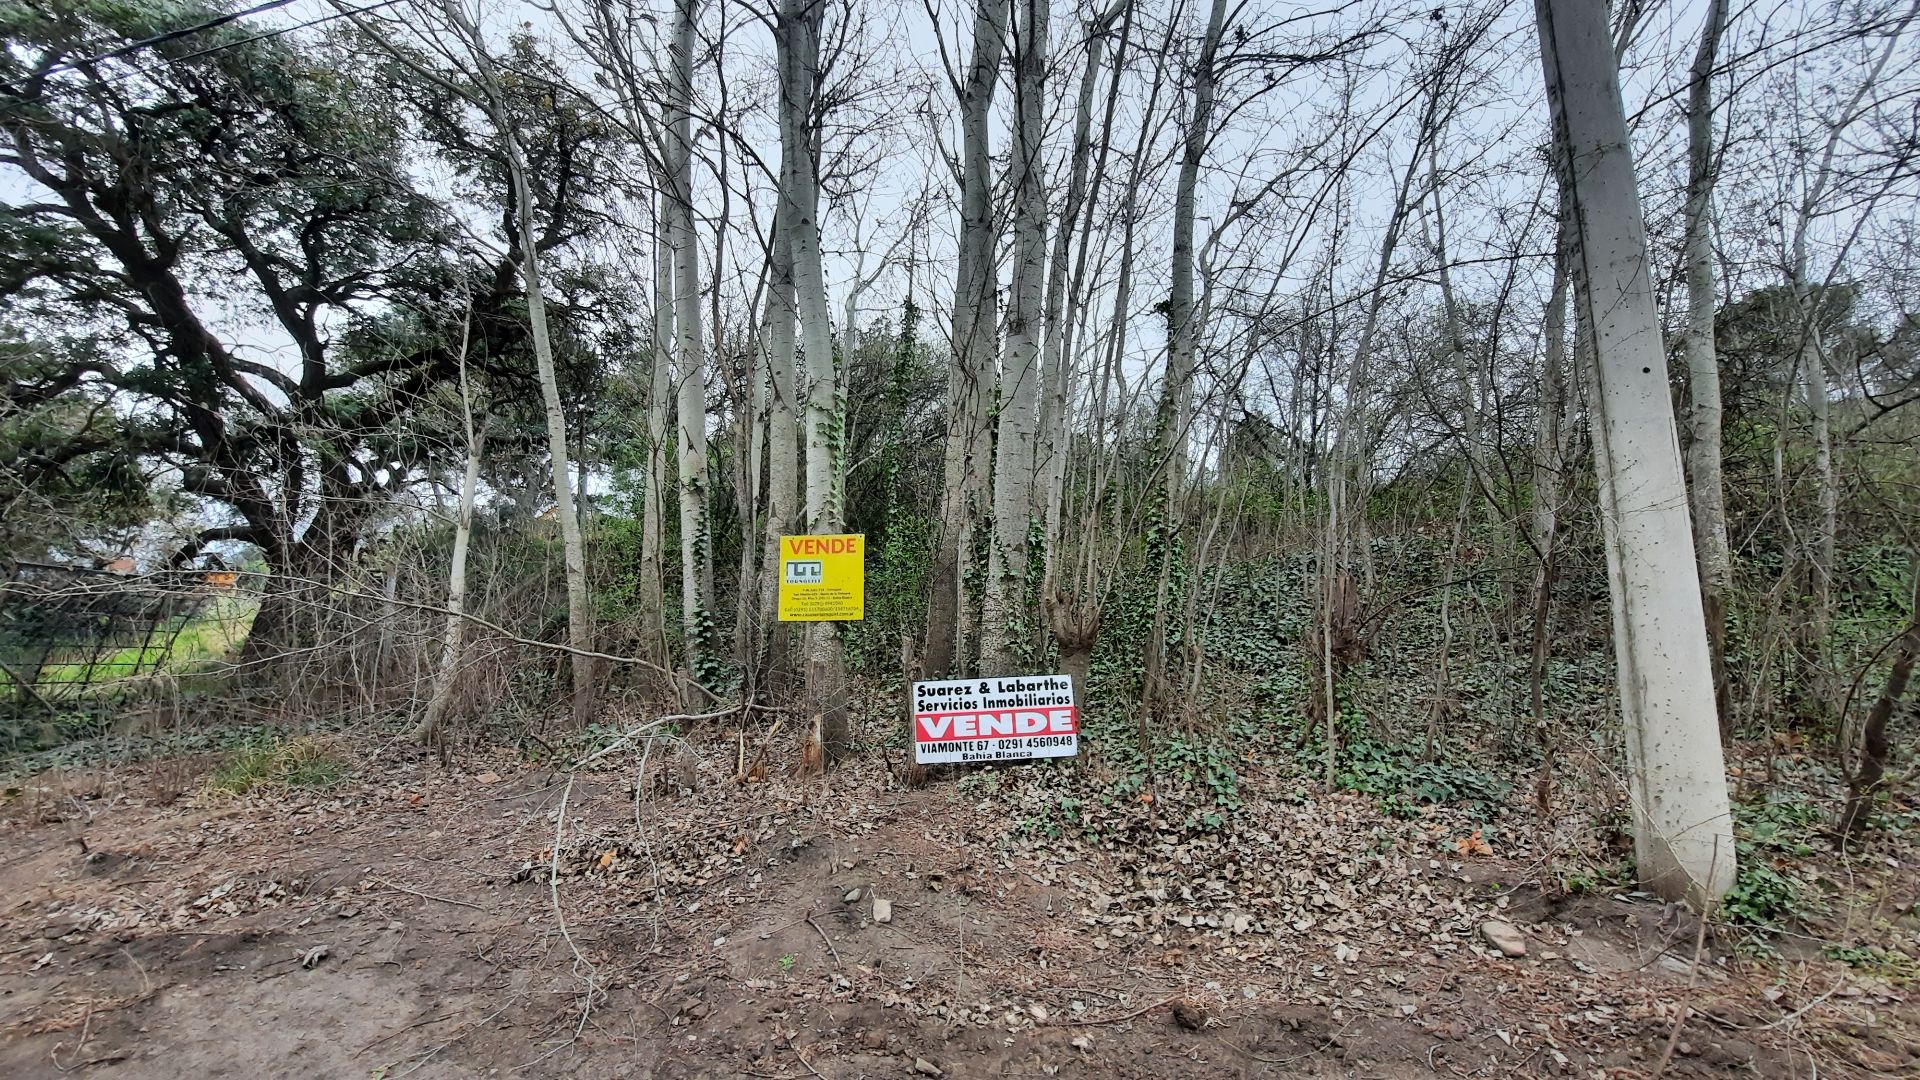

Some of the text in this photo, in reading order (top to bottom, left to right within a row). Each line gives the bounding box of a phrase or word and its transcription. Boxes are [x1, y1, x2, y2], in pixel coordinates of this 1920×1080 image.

[789, 538, 856, 555] VENDE
[917, 678, 1068, 698] Suarez & Labarthe
[918, 693, 1070, 713] Servicios Inmobiliarios
[918, 709, 1073, 739] VENDE
[920, 741, 974, 754] VIAMONTE
[977, 740, 989, 751] 67
[998, 738, 1022, 750] 0291
[1026, 735, 1073, 748] 4560948
[995, 750, 1033, 759] Blanca
